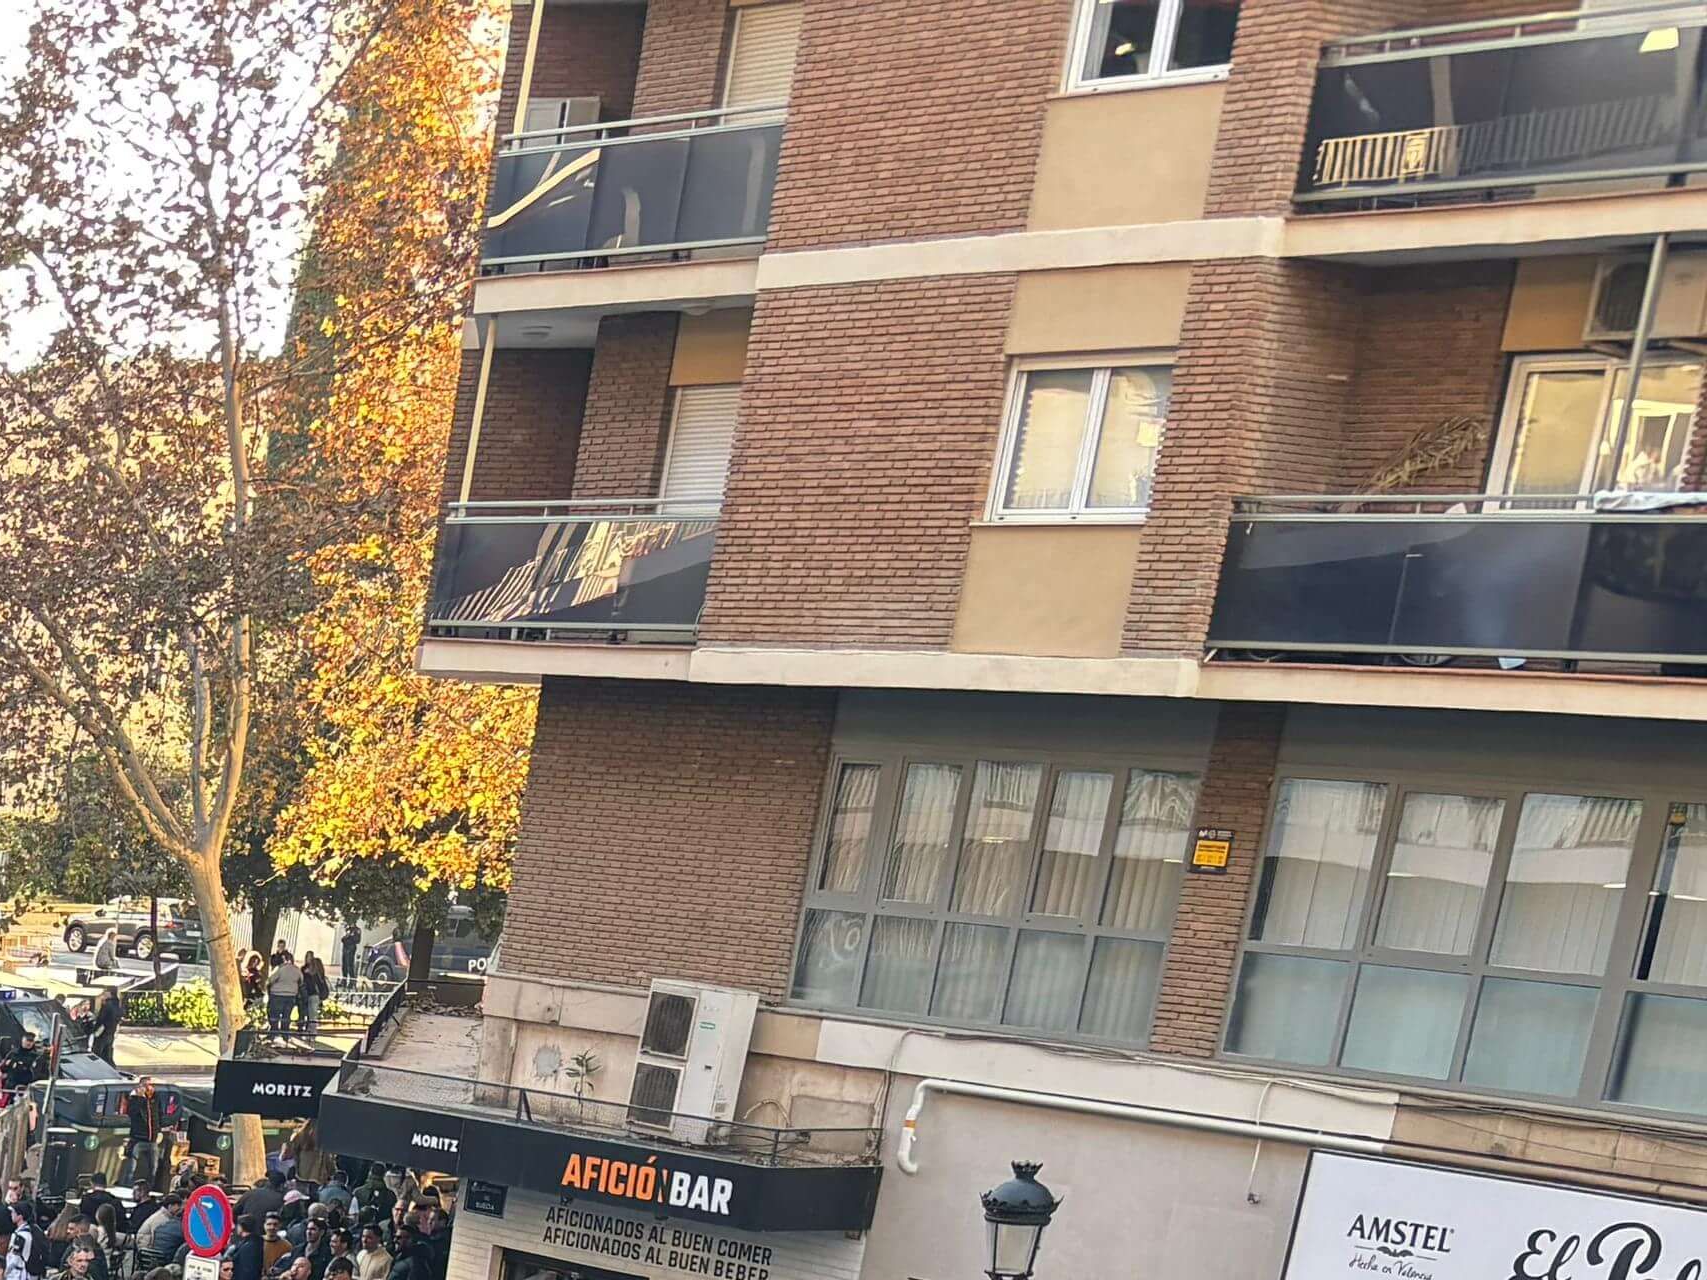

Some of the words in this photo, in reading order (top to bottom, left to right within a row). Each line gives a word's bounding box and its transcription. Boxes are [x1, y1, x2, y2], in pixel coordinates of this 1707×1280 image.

[252, 1082, 313, 1098] MORITZ
[411, 1132, 460, 1153] MORITZ
[669, 1171, 734, 1215] BAR
[542, 1226, 641, 1261] AFICIONADOS
[644, 1246, 664, 1265] AL
[667, 1249, 710, 1275] BUEN
[545, 1206, 645, 1240] AFICIONADOS
[647, 1227, 667, 1245] AL
[671, 1229, 715, 1255] BUEN
[716, 1239, 773, 1266] COMER
[1346, 1213, 1451, 1253] AMSTEL
